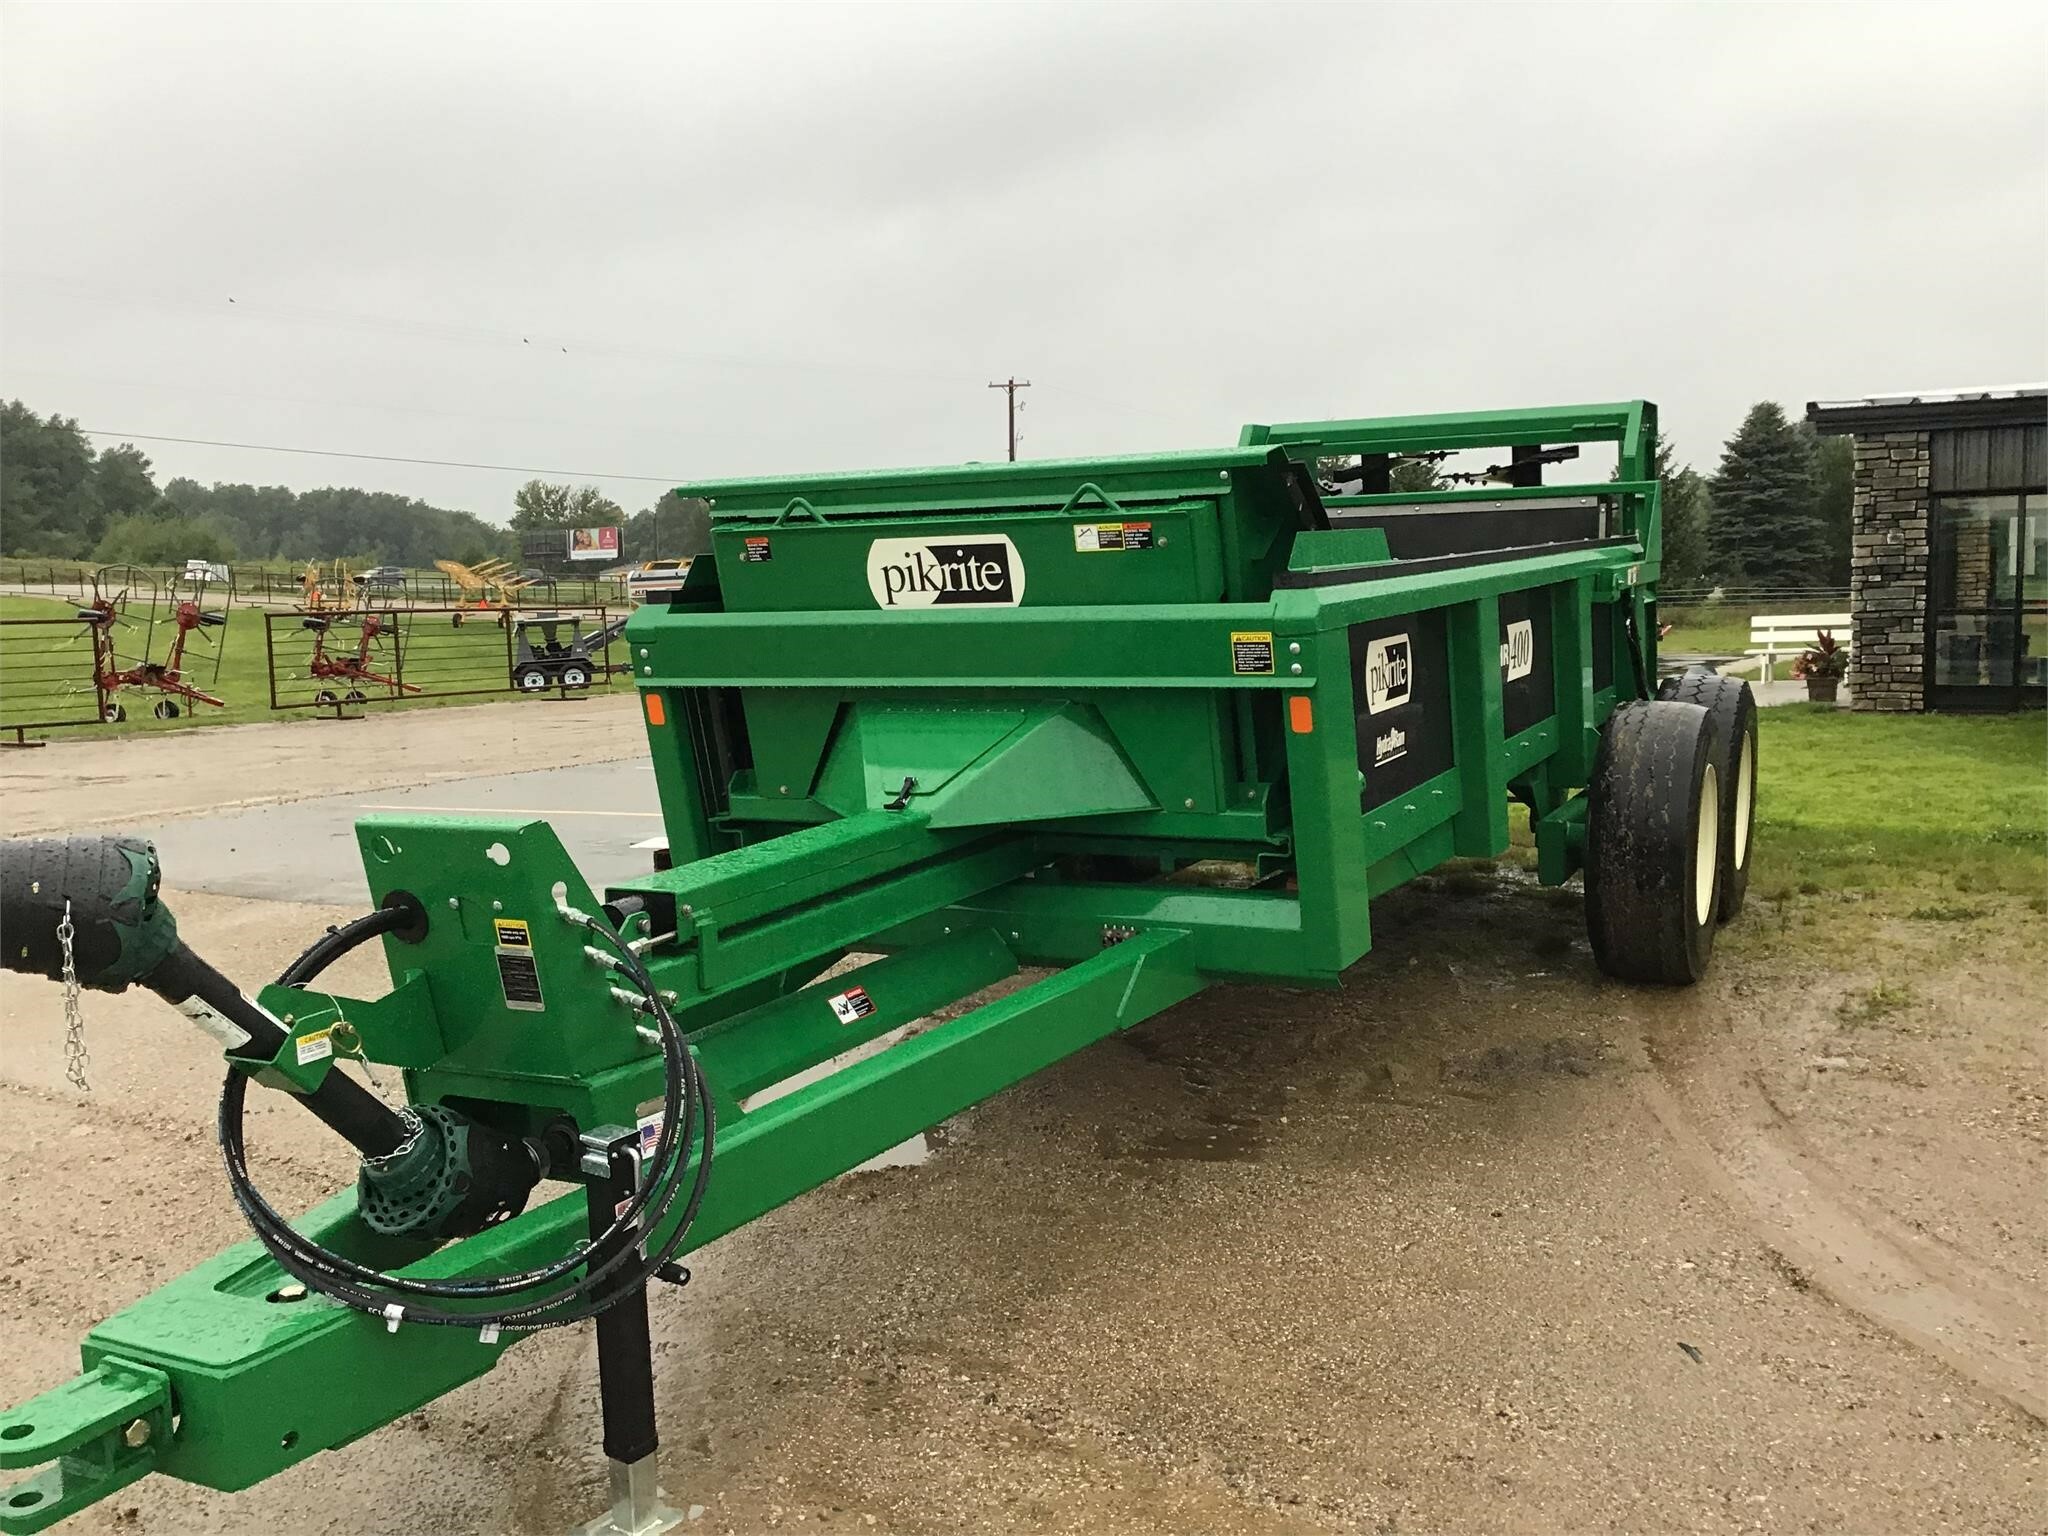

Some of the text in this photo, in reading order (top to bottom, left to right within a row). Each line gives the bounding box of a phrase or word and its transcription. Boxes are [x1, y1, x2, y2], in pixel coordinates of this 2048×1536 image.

[881, 550, 1004, 605] pikrite
[1510, 629, 1530, 670] 400
[1370, 648, 1407, 706] pikrite
[304, 1031, 329, 1043] CAUTION
